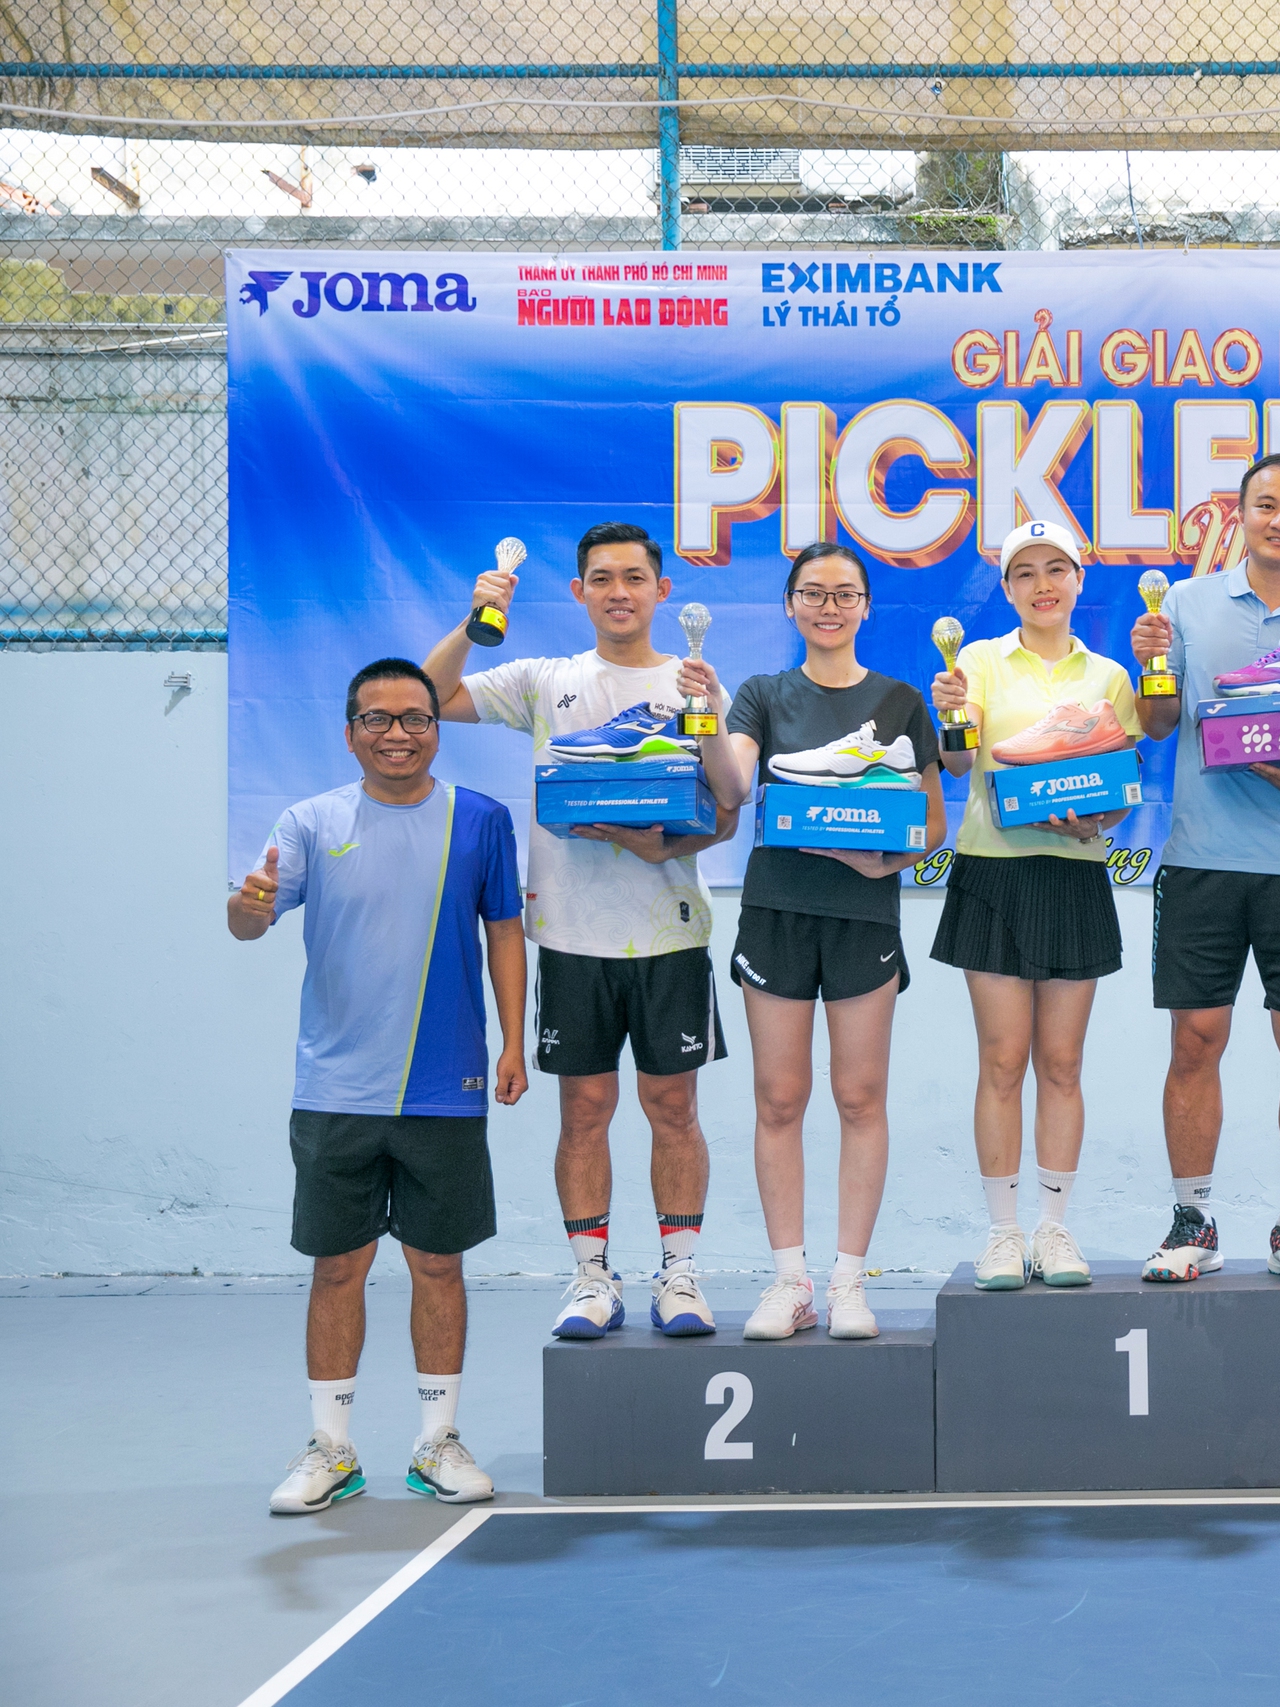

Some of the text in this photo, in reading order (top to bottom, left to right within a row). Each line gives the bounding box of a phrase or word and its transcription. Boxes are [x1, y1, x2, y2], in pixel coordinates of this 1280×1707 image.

[624, 260, 648, 281] PHỐ
[652, 260, 668, 281] HỒ
[673, 262, 693, 281] CHÍ
[697, 265, 728, 281] MINH
[761, 261, 1003, 294] EXIMBANK
[517, 294, 729, 328] NGƯỜI LAO ĐỘNG
[762, 294, 902, 327] LÝ THÁI TỔ
[950, 307, 1083, 388] GIẢI
[1099, 327, 1263, 388] GIAO
[1031, 523, 1045, 537] C
[567, 799, 587, 807] TESTED
[640, 797, 668, 805] ATHLETES
[1029, 799, 1045, 807] TESTED
[1052, 795, 1085, 804] PROFESSIONAL
[1086, 790, 1109, 799] ATHLETES
[735, 953, 749, 969] NIKE
[752, 973, 760, 982] DO
[1115, 1328, 1149, 1416] 1
[704, 1371, 754, 1460] 2
